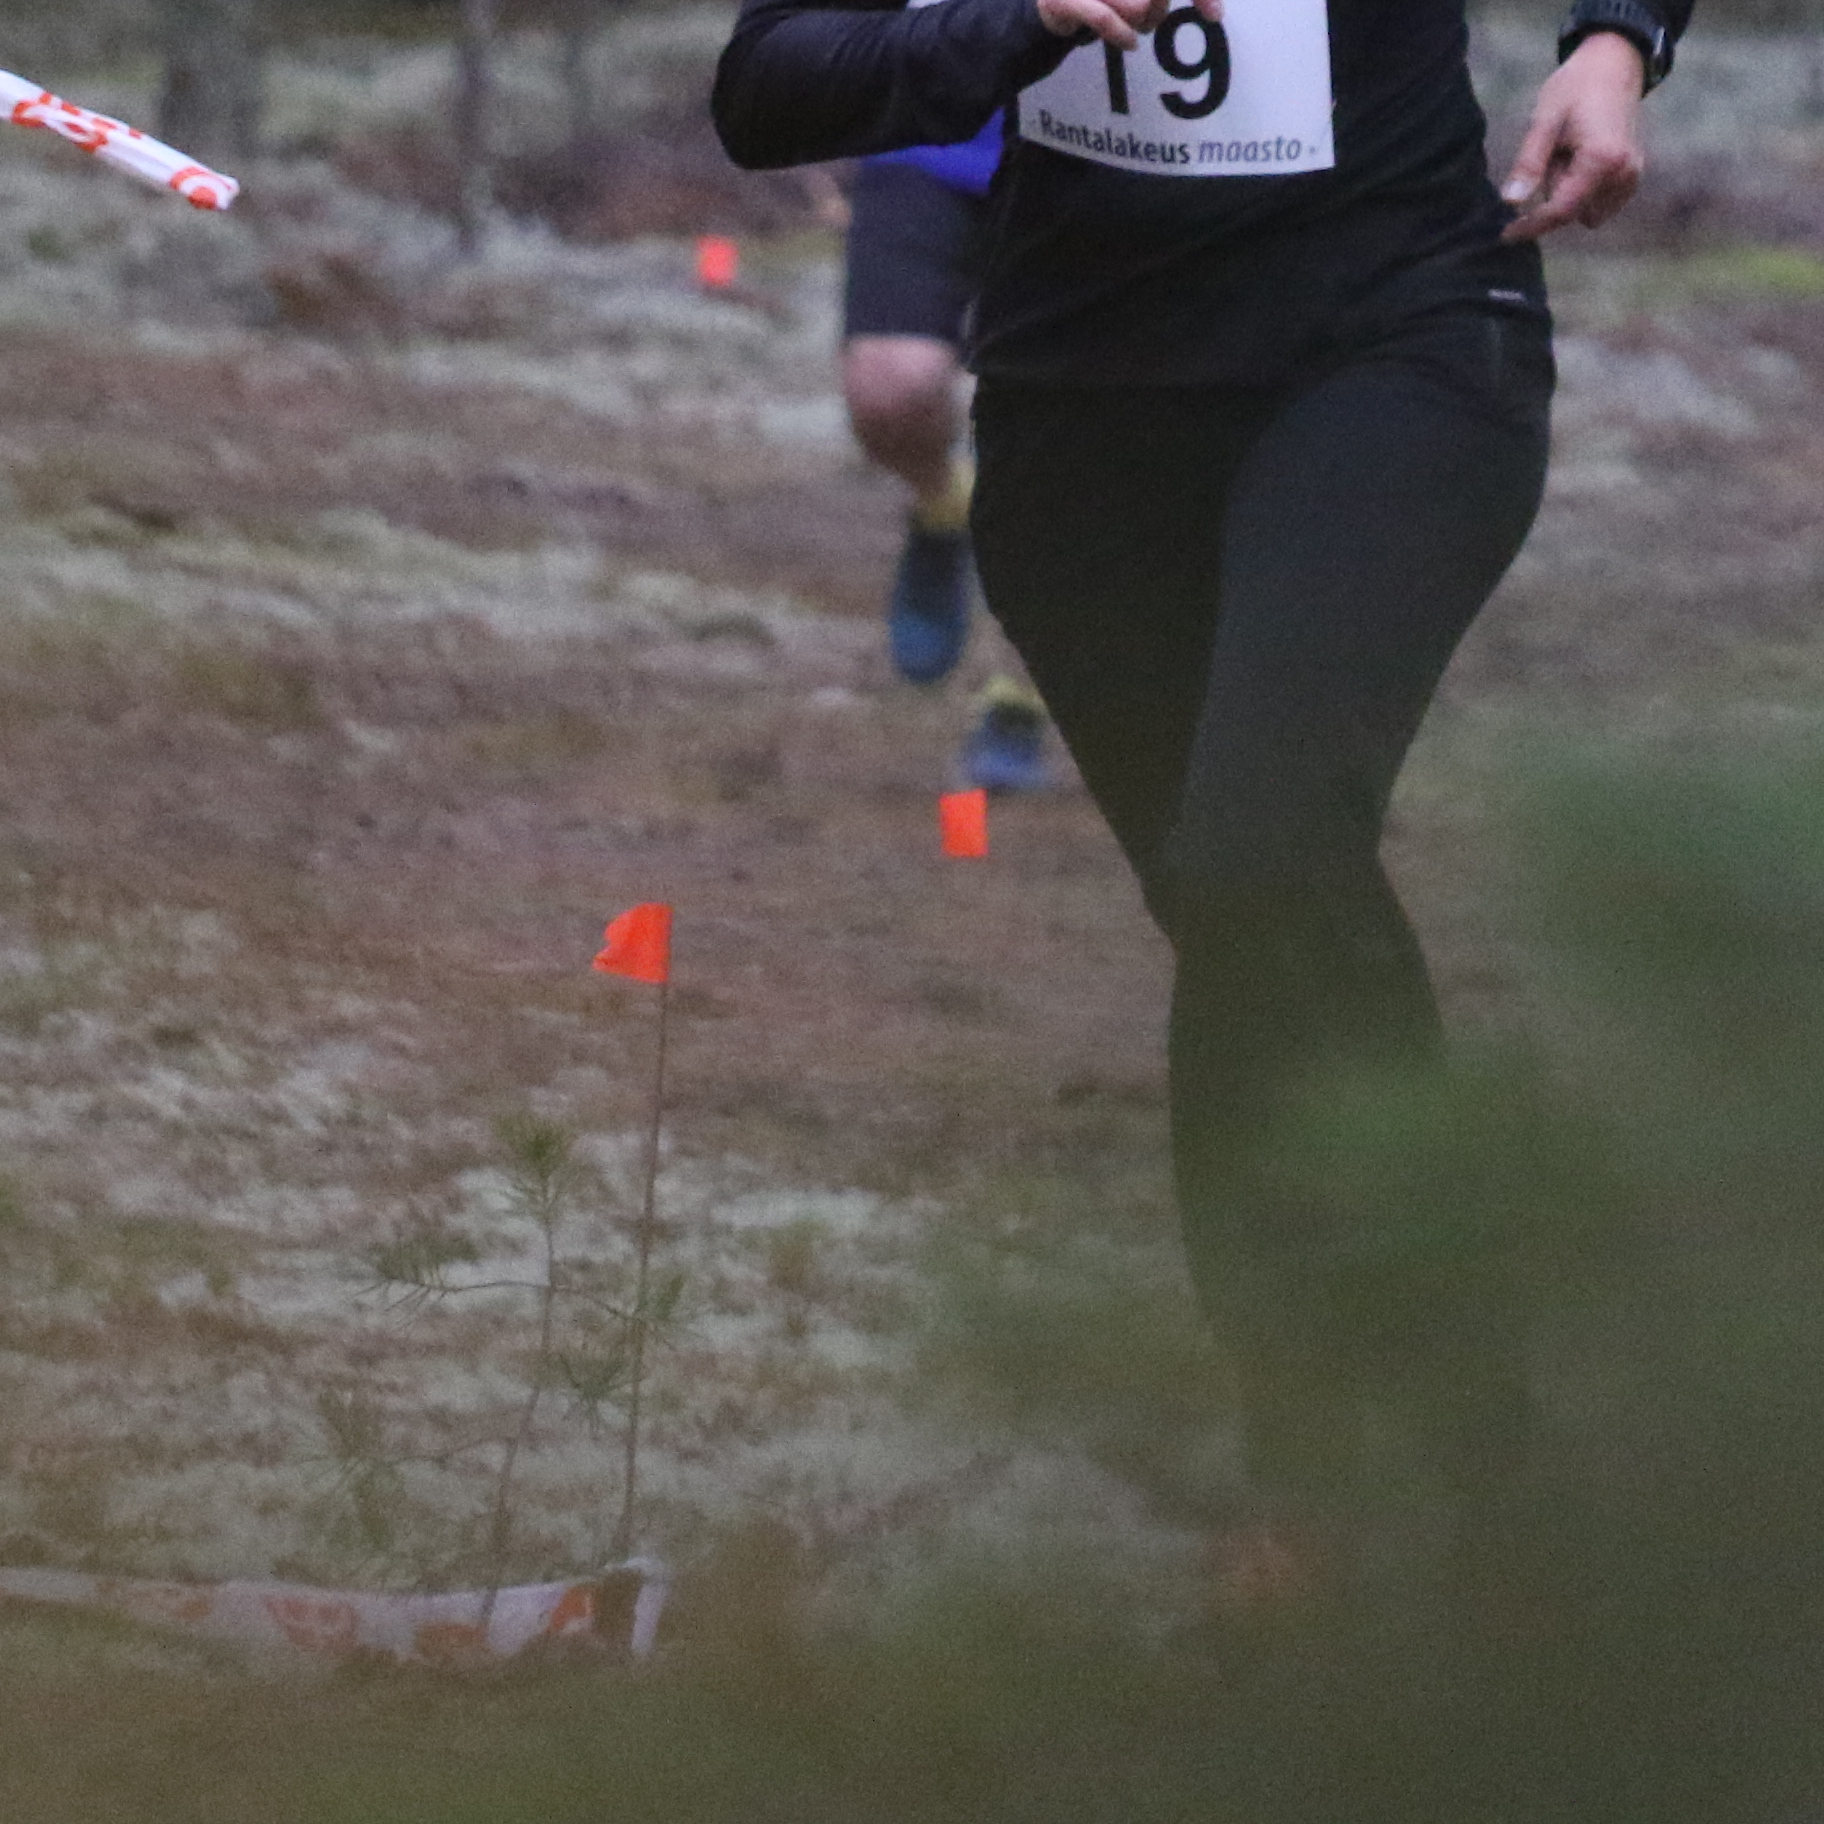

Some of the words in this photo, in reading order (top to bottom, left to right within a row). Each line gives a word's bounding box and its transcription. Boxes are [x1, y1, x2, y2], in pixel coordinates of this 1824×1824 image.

[1103, 5, 1232, 120] 19
[1039, 109, 1190, 164] Rantalakeus
[1198, 135, 1301, 163] maasto
